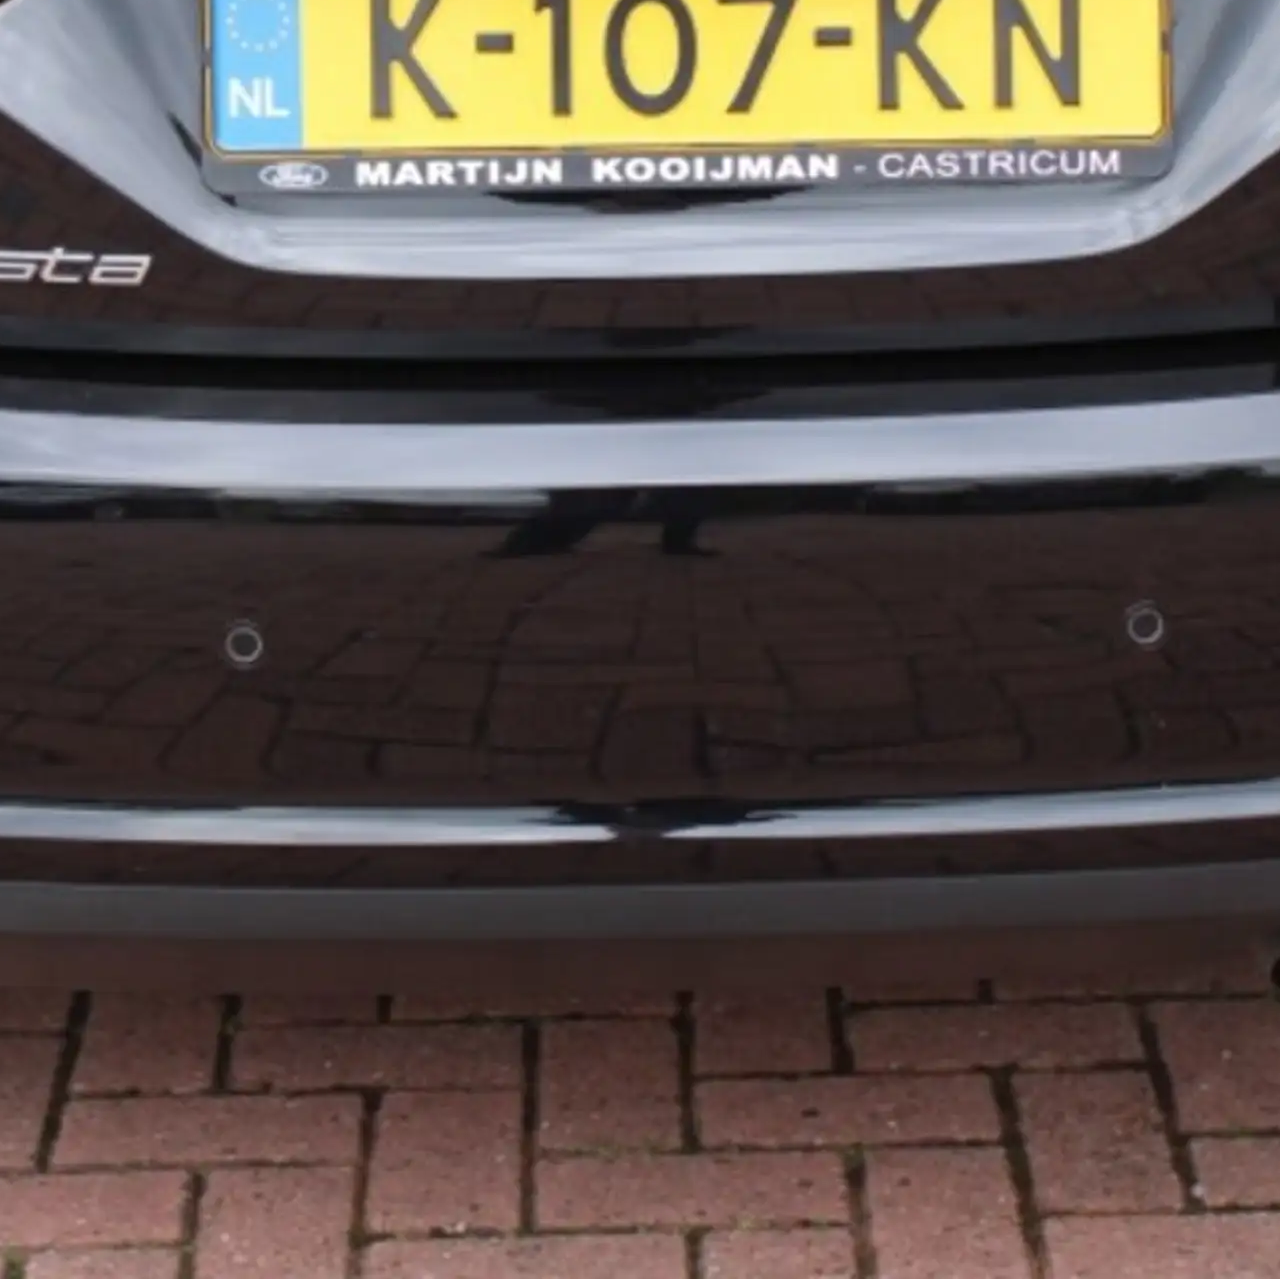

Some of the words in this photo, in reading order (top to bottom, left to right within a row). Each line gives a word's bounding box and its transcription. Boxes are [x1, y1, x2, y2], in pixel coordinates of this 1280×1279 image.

[227, 77, 291, 119] NL
[354, 157, 563, 188] MARTIJN
[591, 153, 839, 183] KOOIJMAN
[876, 148, 1121, 180] CASTRICUM
